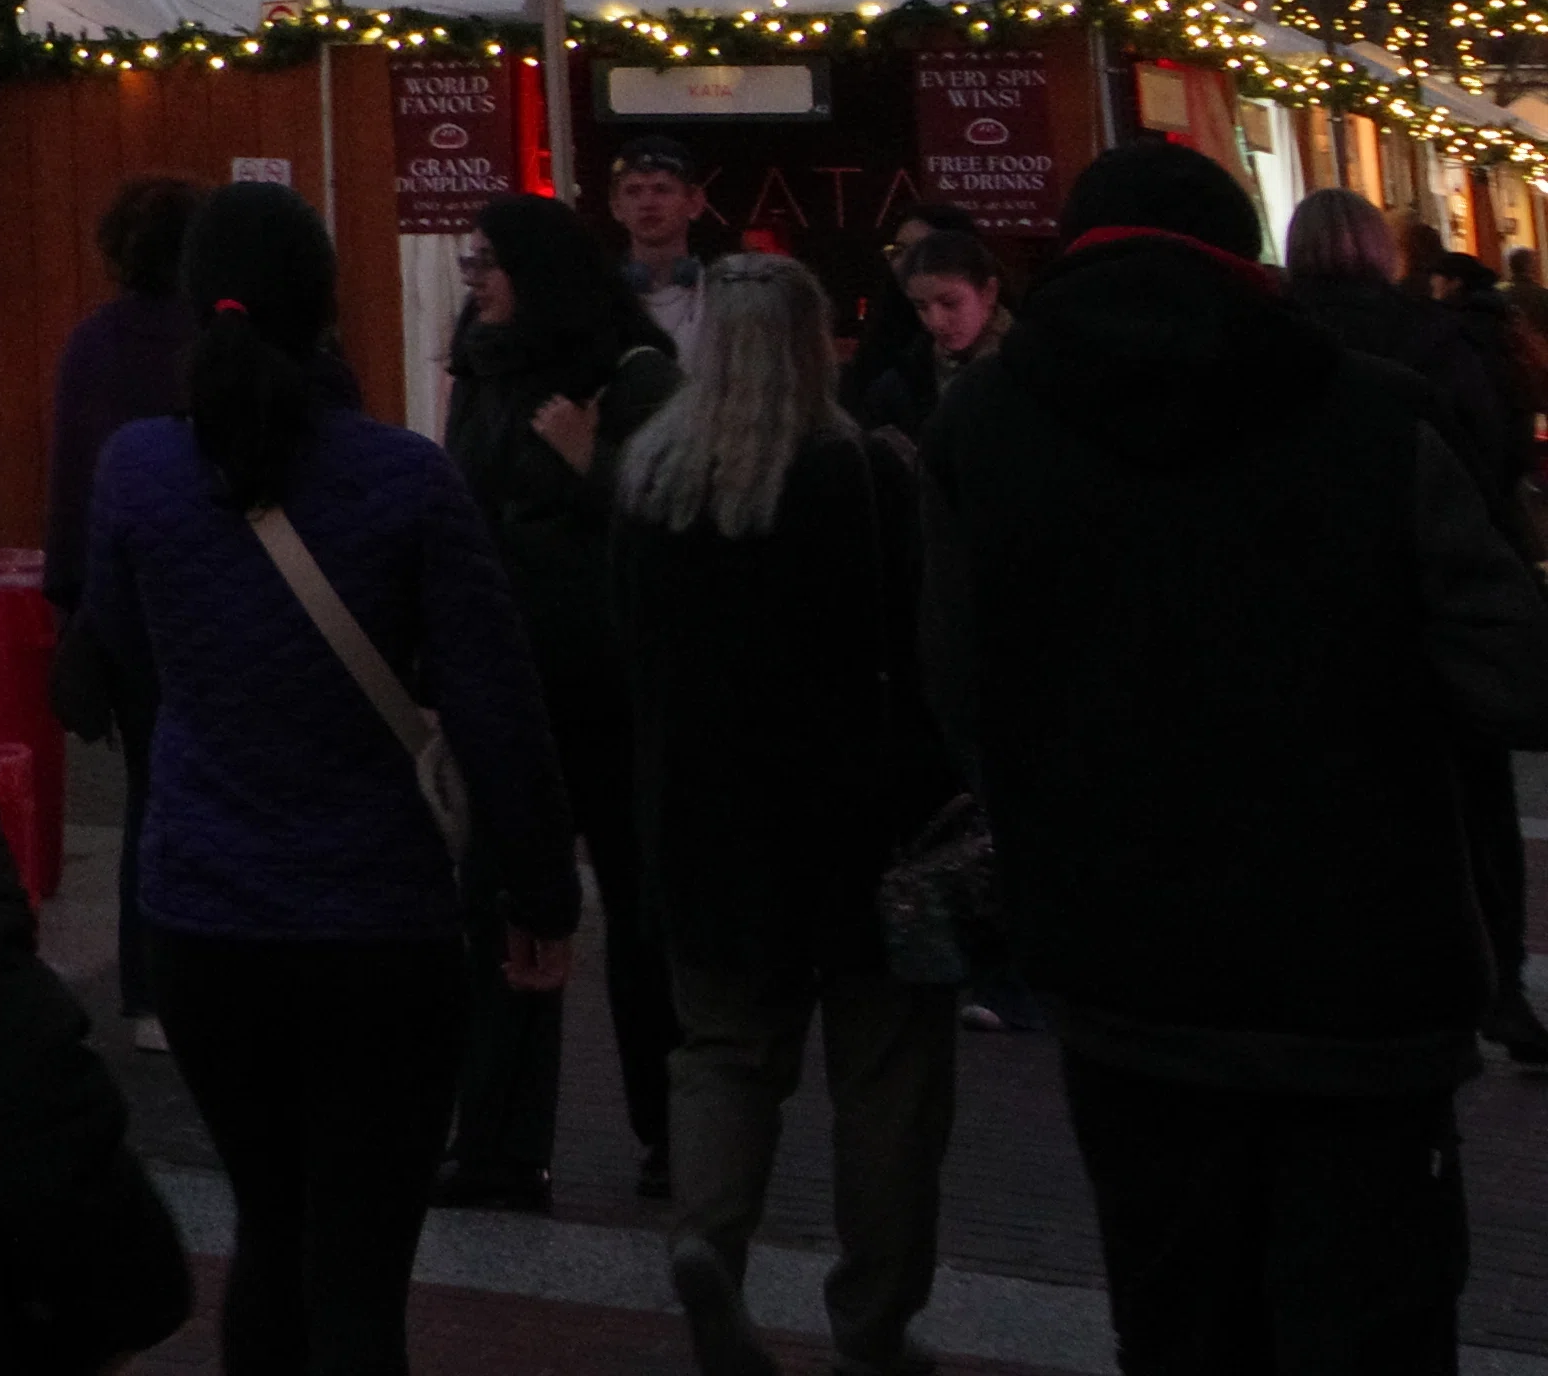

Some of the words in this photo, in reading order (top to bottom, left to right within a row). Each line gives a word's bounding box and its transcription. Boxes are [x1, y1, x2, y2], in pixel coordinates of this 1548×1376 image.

[403, 76, 490, 95] WORLD
[919, 69, 988, 88] EVERY
[995, 68, 1046, 86] SPIN
[688, 84, 733, 97] KATA
[947, 89, 1022, 108] WINS!
[399, 95, 496, 115] FAMOUS
[409, 157, 491, 176] GRAND
[927, 155, 982, 172] FREE
[987, 155, 1052, 172] FOOD
[394, 175, 510, 193] DUMPLINGS
[937, 174, 958, 190] &
[963, 174, 1045, 190] DRINKS
